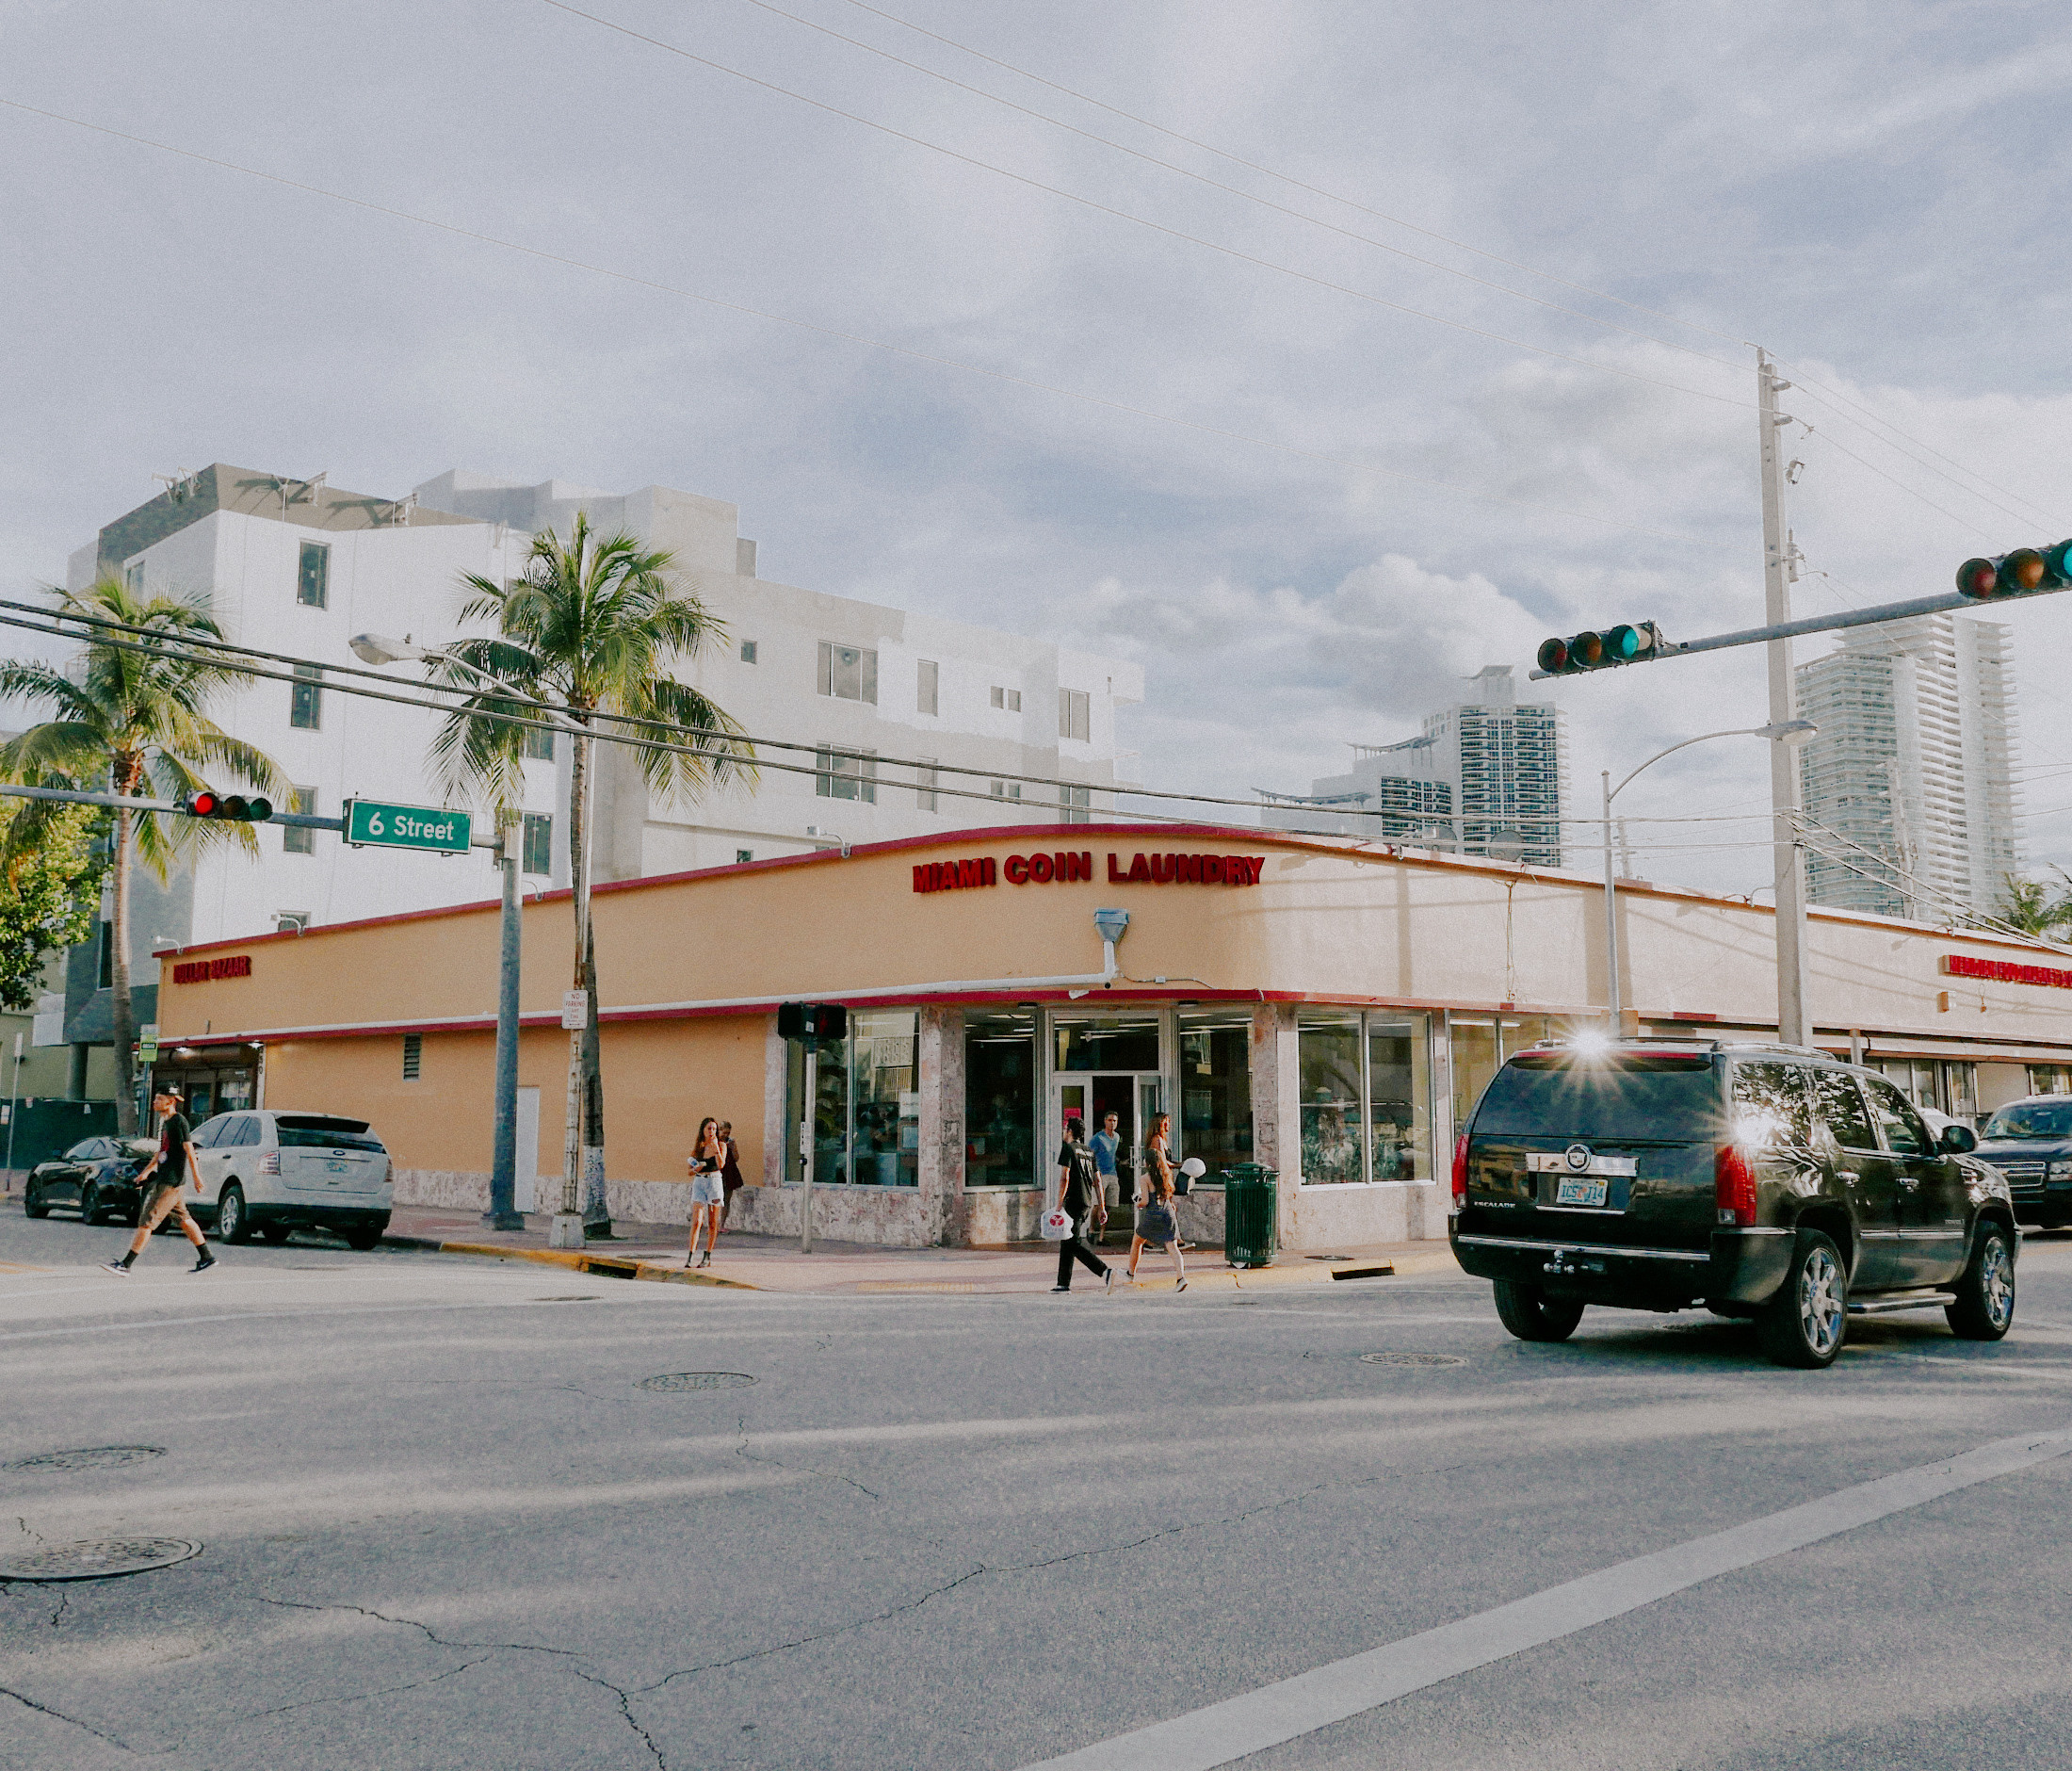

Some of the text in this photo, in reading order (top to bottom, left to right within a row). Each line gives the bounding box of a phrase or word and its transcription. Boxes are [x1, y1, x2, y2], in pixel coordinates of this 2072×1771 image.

[368, 811, 454, 840] 6 Street
[913, 852, 1265, 893] MIAMI COIN LAUNDRY
